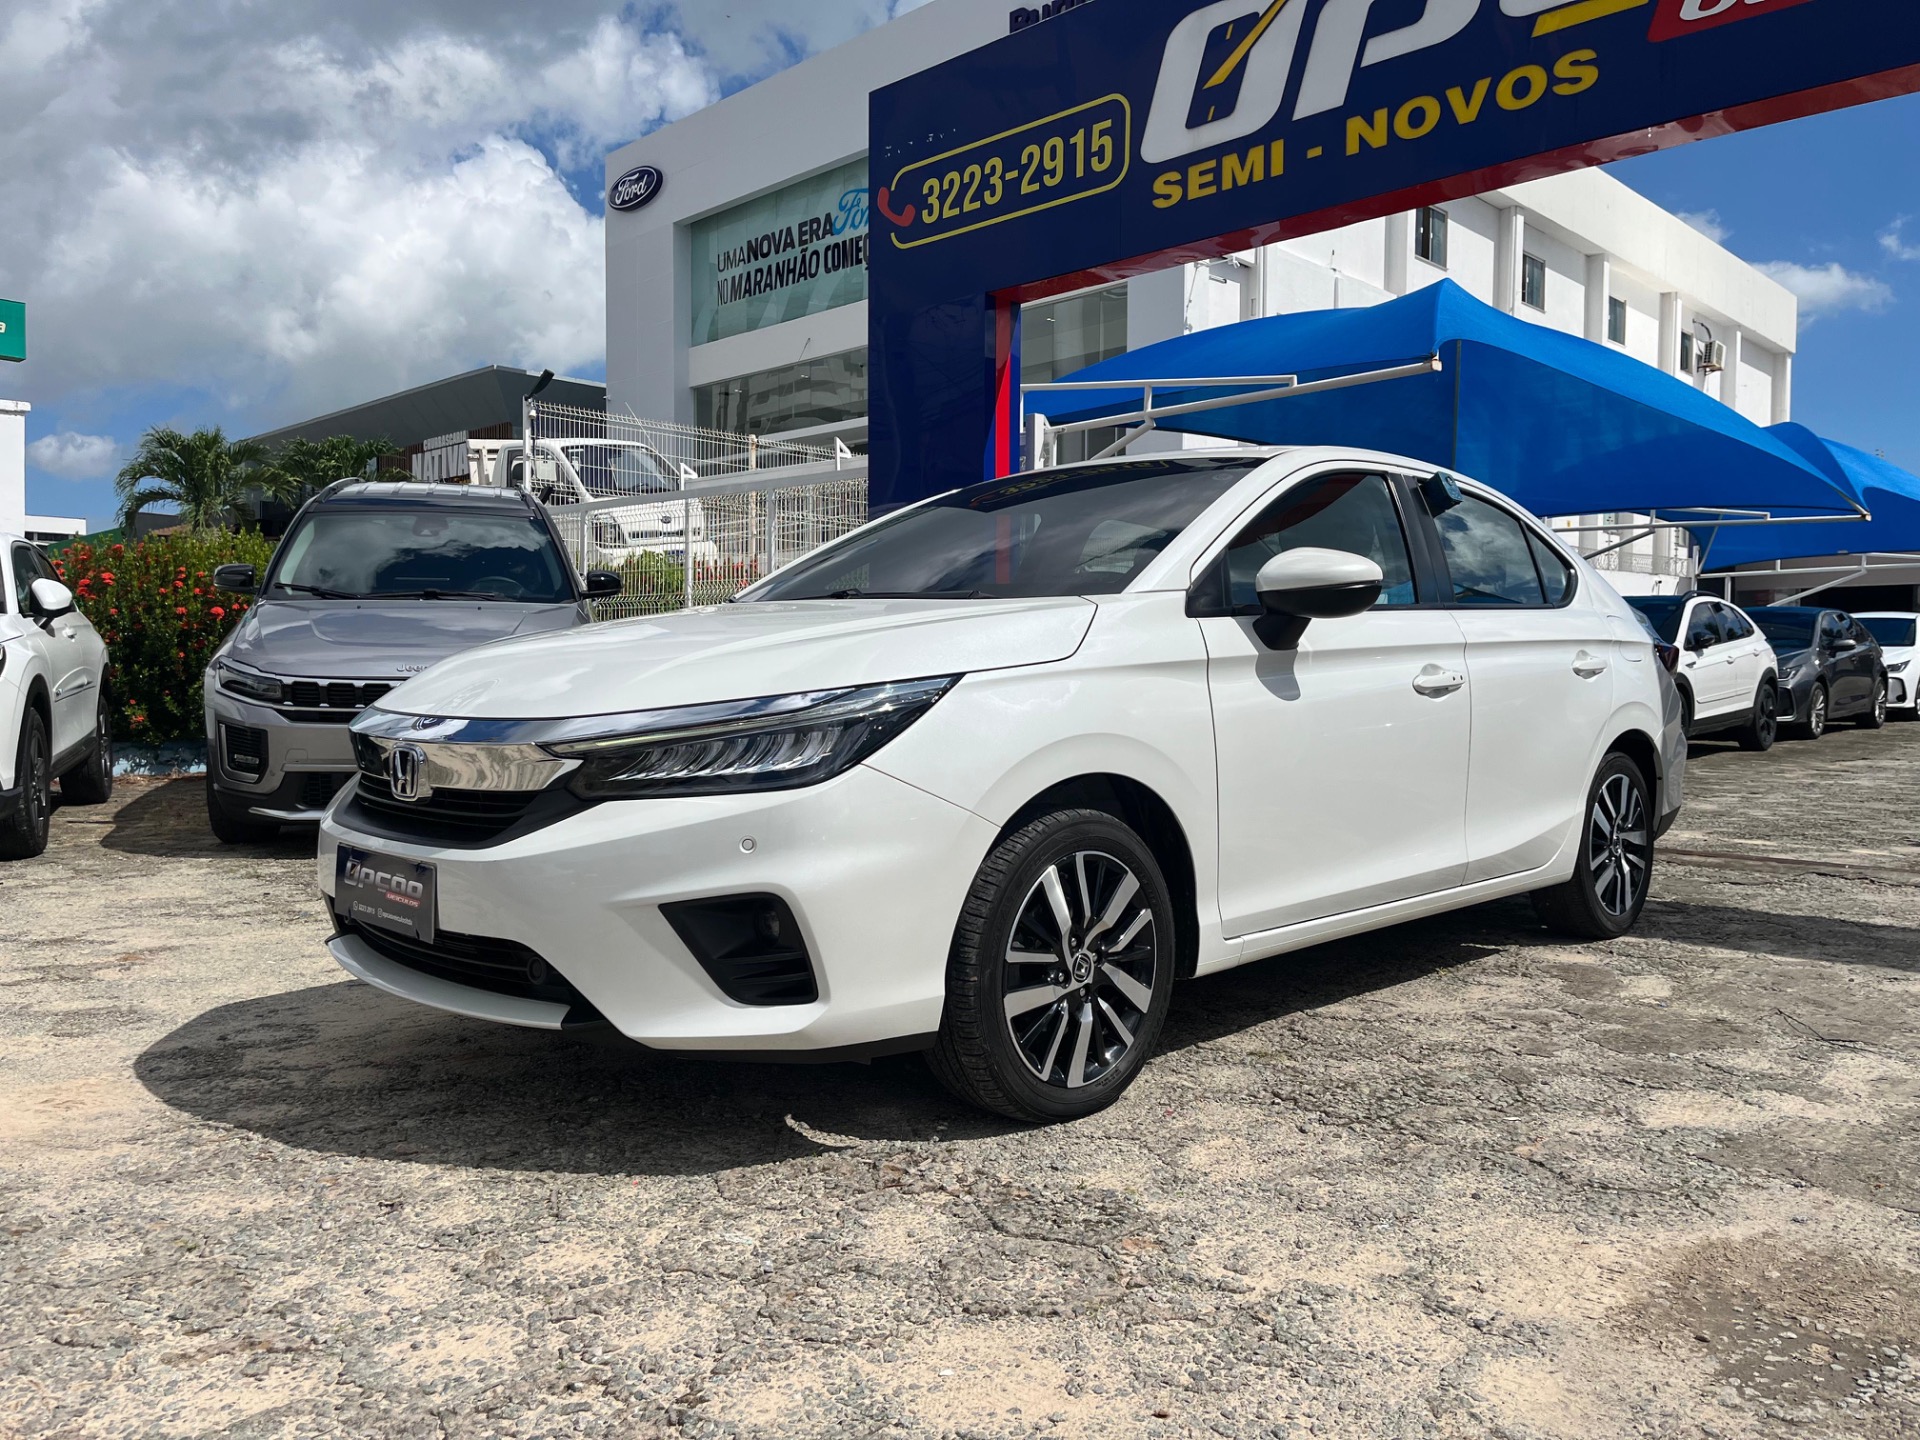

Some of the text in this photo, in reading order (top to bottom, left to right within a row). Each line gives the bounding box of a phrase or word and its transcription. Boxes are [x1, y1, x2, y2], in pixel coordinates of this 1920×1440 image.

[1152, 139, 1285, 209] SEMI
[1345, 48, 1600, 157] NOVOS
[614, 172, 648, 205] Ford
[921, 118, 1113, 224] 3223-2915
[716, 246, 748, 273] UMA
[746, 226, 796, 264] NOVA
[797, 212, 834, 248] ERA
[717, 278, 728, 306] NO
[729, 247, 821, 303] MARANHÃO
[411, 442, 470, 482] NATIVA
[344, 857, 423, 899] OPÇÃO
